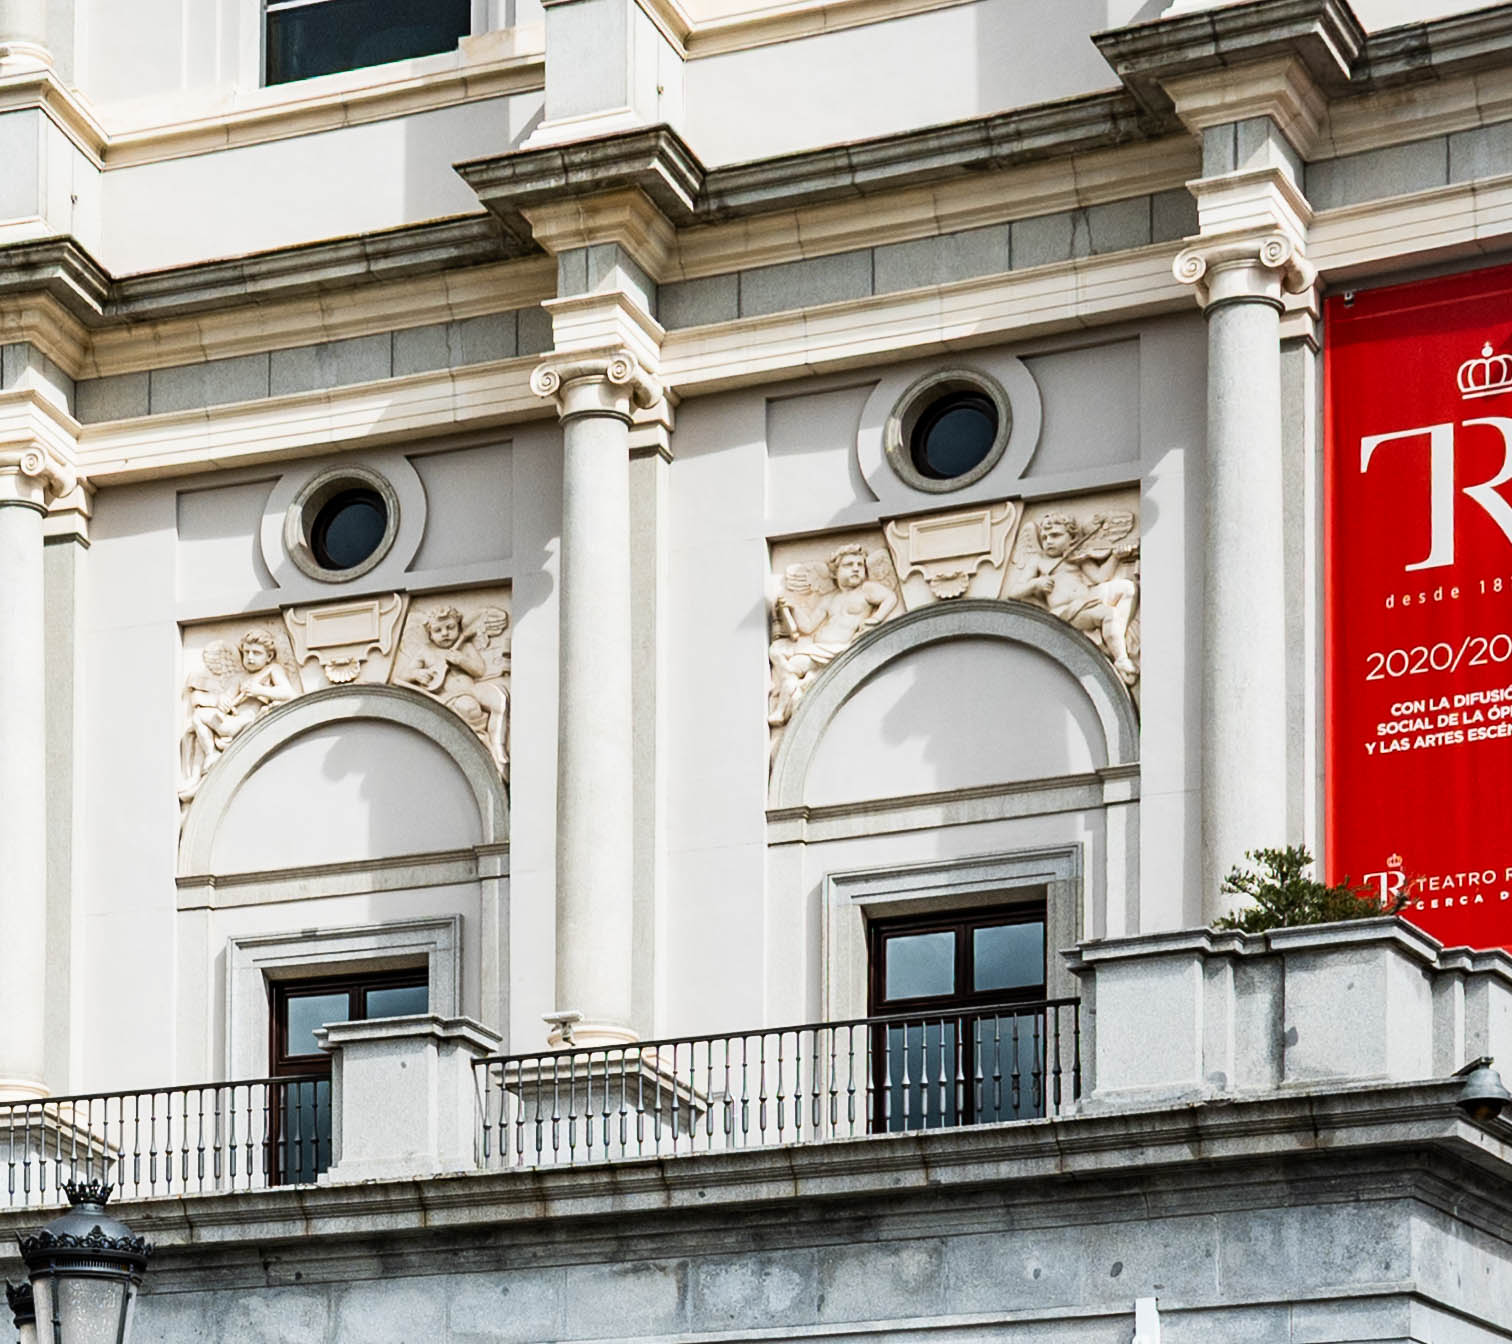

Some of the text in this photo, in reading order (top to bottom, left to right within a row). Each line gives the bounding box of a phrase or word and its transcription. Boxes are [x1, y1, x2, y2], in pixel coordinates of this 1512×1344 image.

[1385, 586, 1460, 608] desde
[1390, 700, 1425, 716] CON
[1429, 696, 1450, 711] LA
[1377, 717, 1434, 736] SOCIAL
[1437, 712, 1459, 728] DE
[1462, 709, 1484, 725] LA
[1365, 742, 1376, 755] Y
[1379, 737, 1410, 754] LAS
[1413, 730, 1464, 749] ARTES
[1416, 869, 1497, 892] TEATRO
[1416, 894, 1484, 911] CERCA
